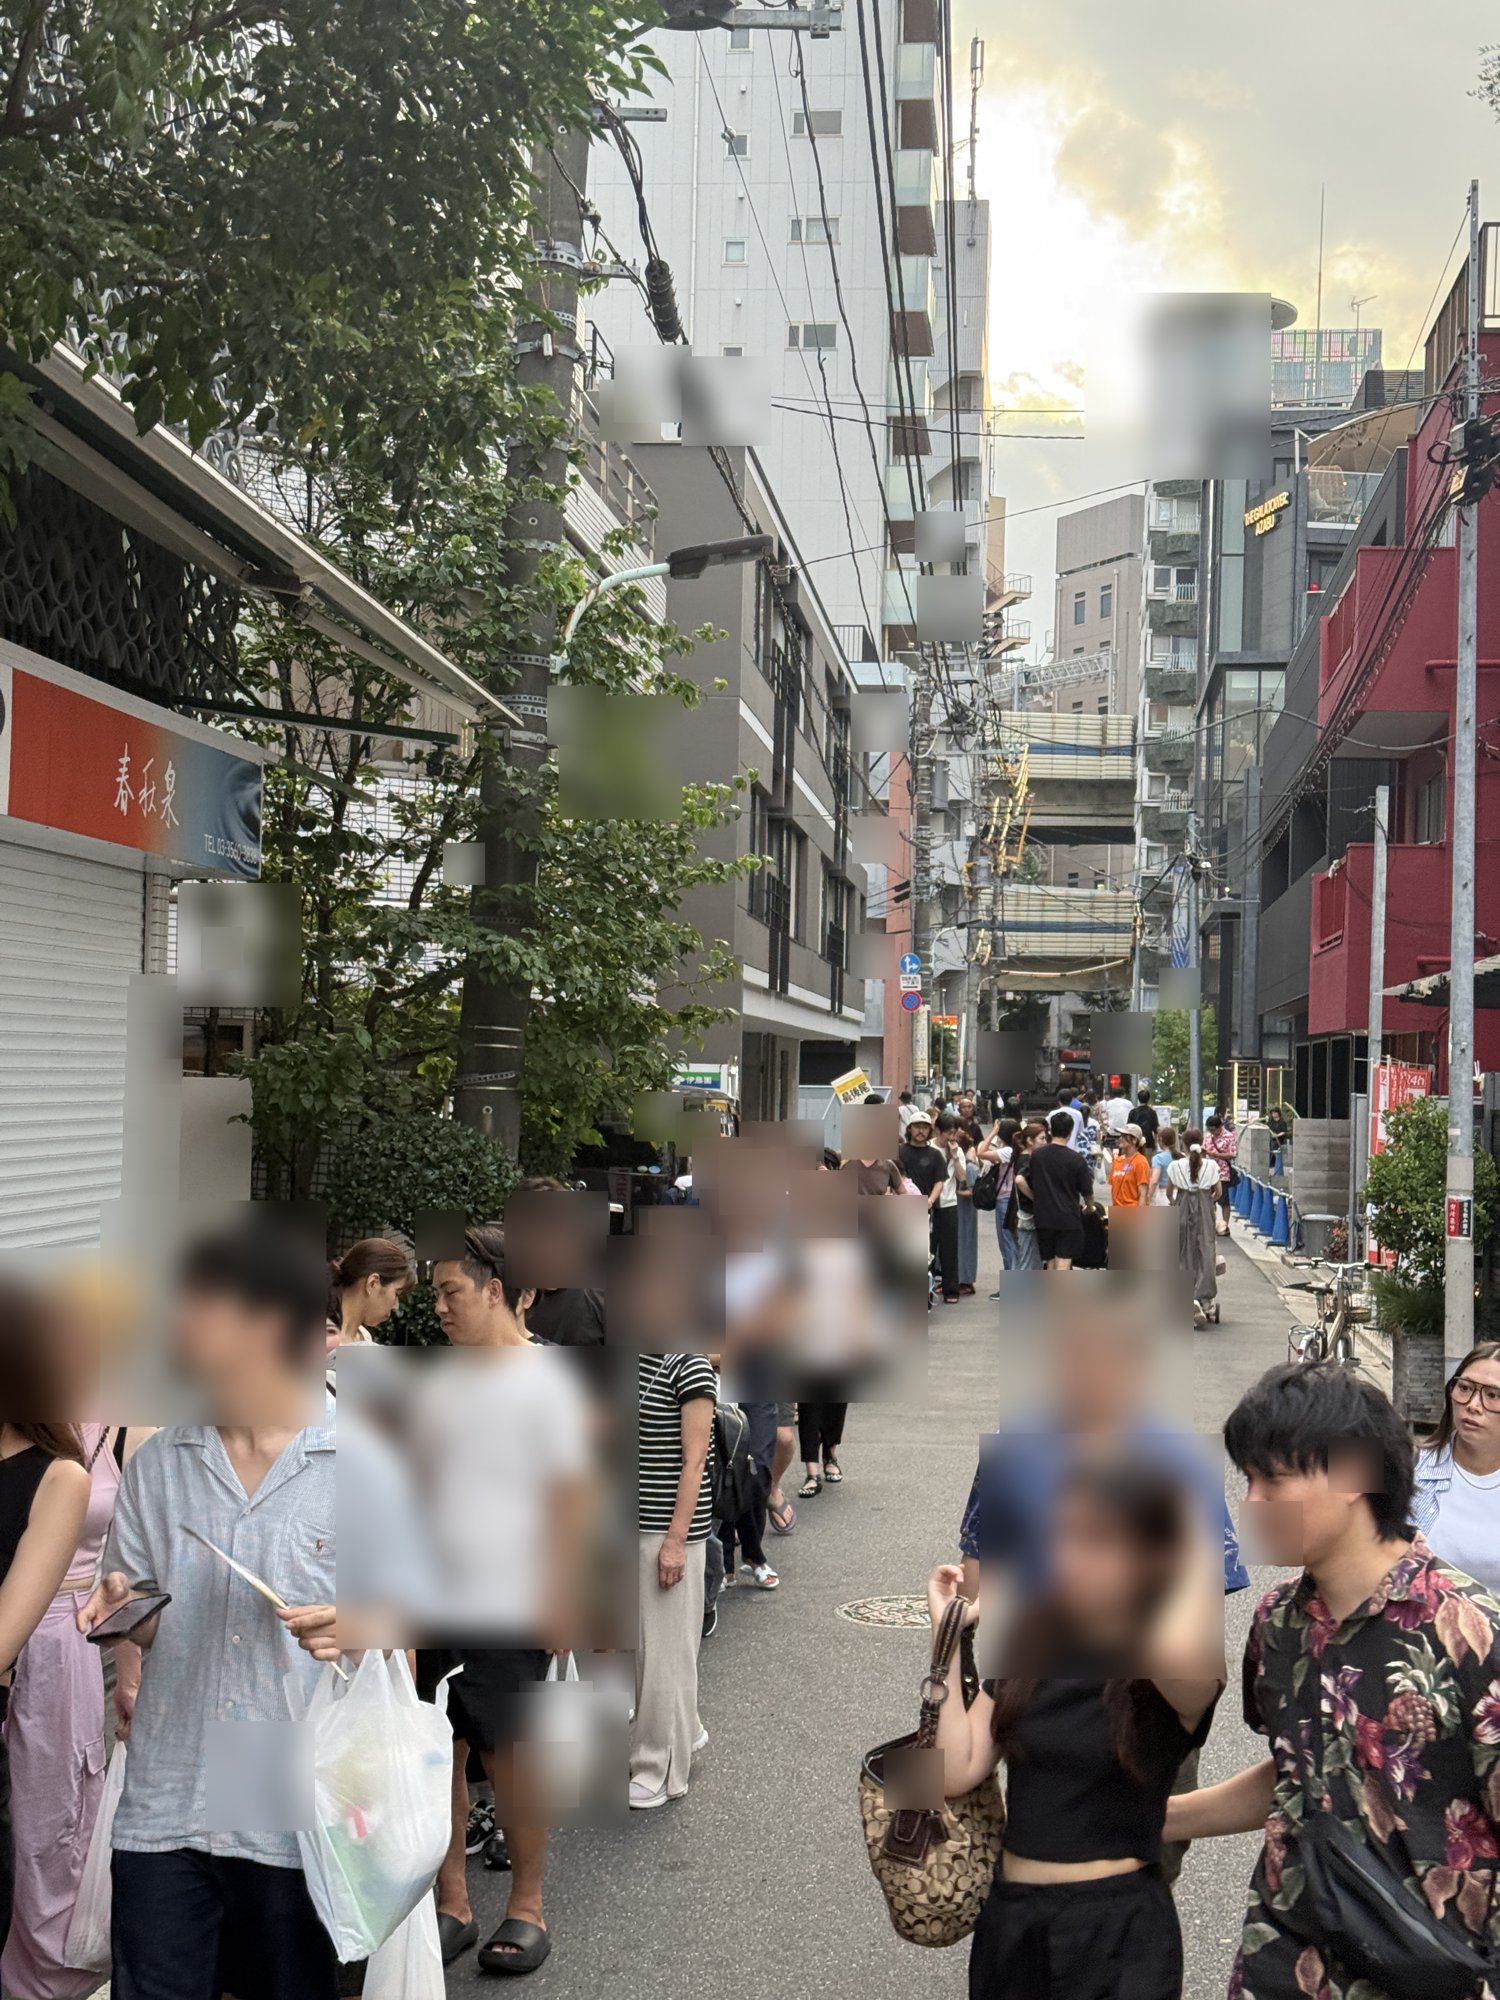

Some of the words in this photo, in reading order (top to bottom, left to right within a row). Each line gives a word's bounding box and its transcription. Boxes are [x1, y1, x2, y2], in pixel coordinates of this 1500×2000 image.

[1255, 513, 1275, 536] AZABU
[113, 742, 180, 829] 春秋泉
[203, 833, 216, 854] TEL
[841, 1081, 871, 1104] 最後尾
